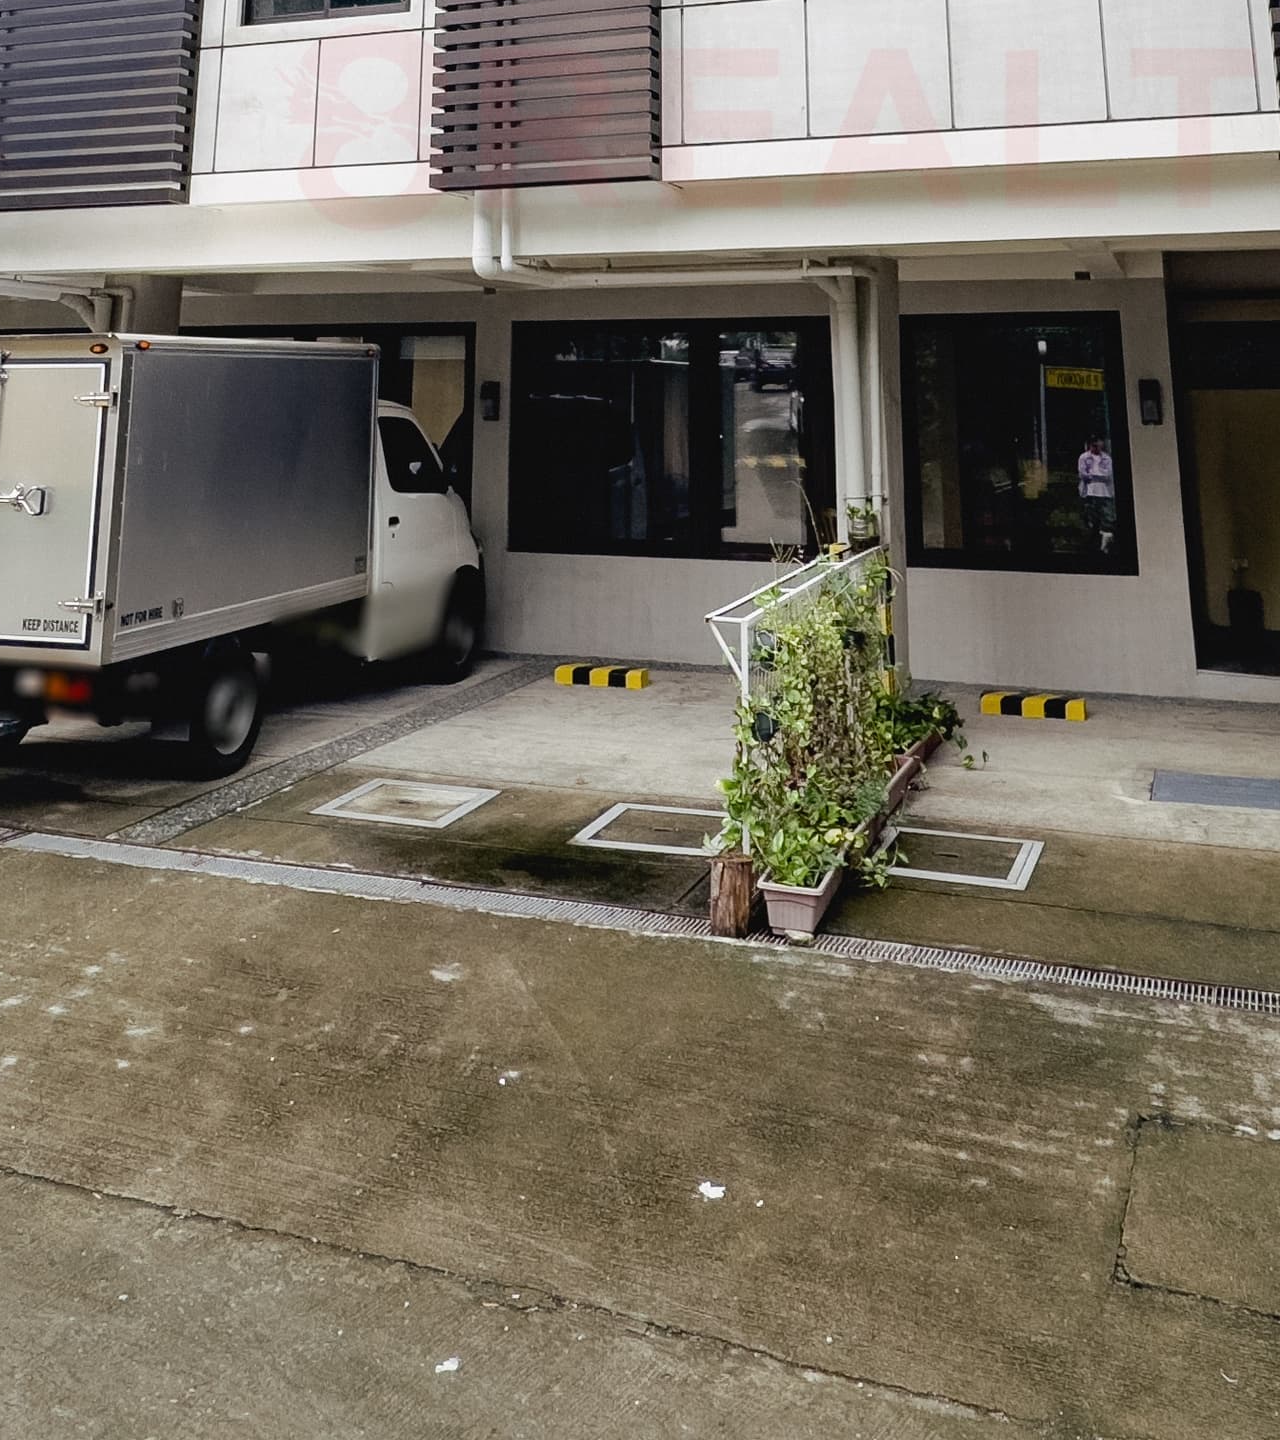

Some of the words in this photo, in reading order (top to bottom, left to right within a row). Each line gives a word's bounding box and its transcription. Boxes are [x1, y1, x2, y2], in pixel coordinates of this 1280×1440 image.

[135, 610, 147, 624] FOR
[22, 618, 41, 631] KEEP
[43, 619, 79, 633] DISTANCE
